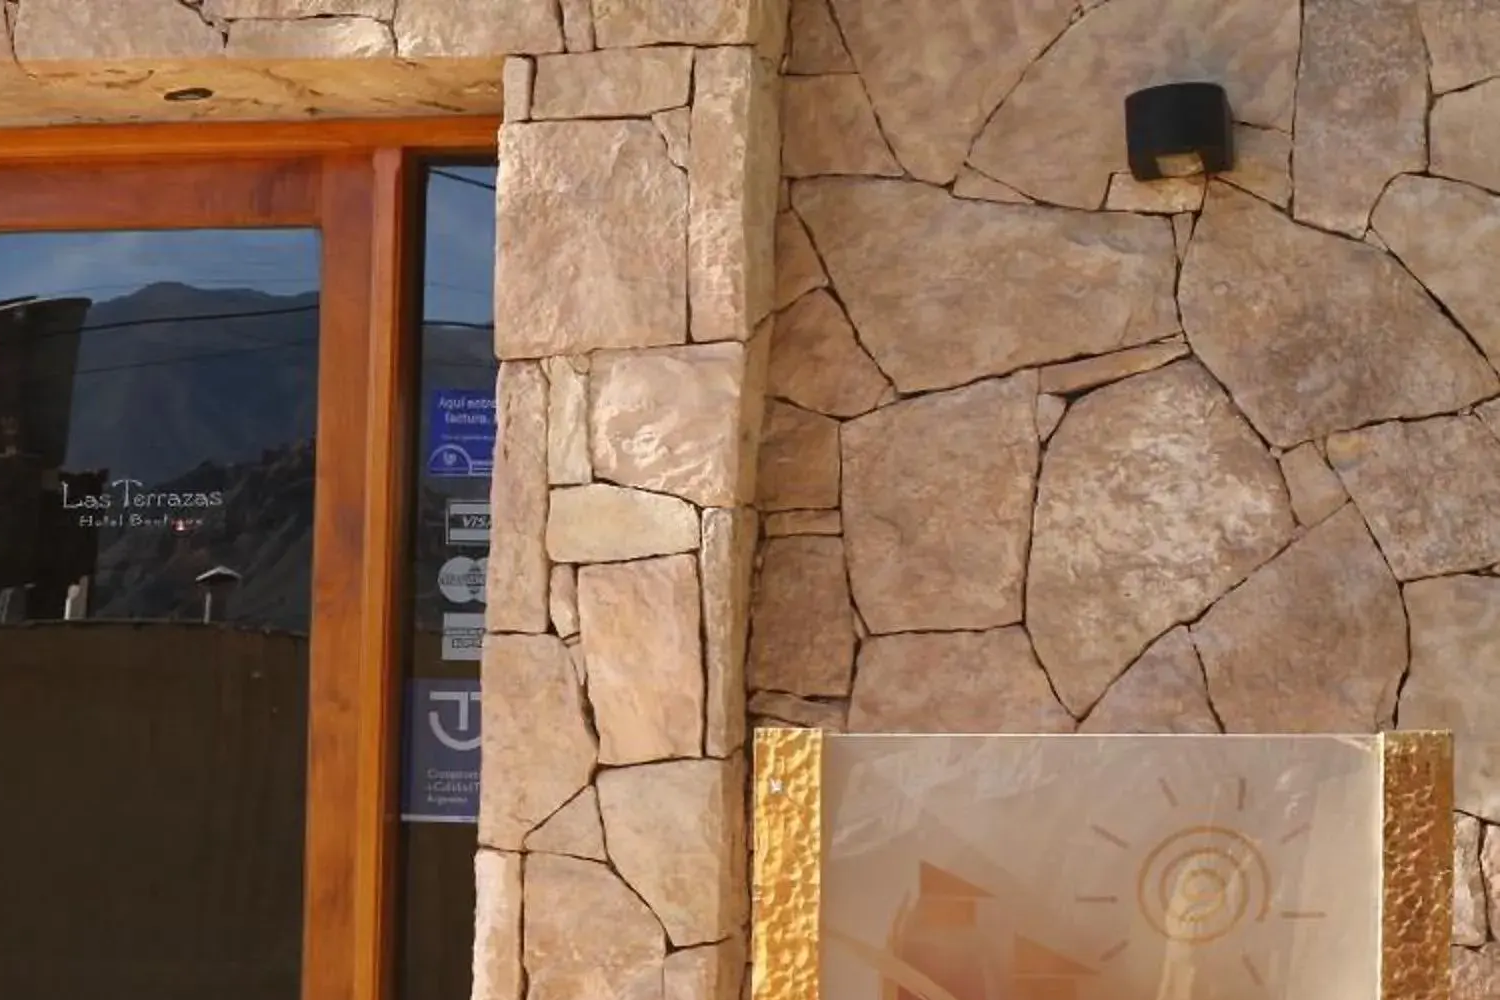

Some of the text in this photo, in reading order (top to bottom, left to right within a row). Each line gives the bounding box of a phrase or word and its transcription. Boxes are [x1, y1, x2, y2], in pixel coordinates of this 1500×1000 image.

[61, 479, 224, 510] Las Terrazas
[79, 514, 203, 529] Hotel Boutiue
